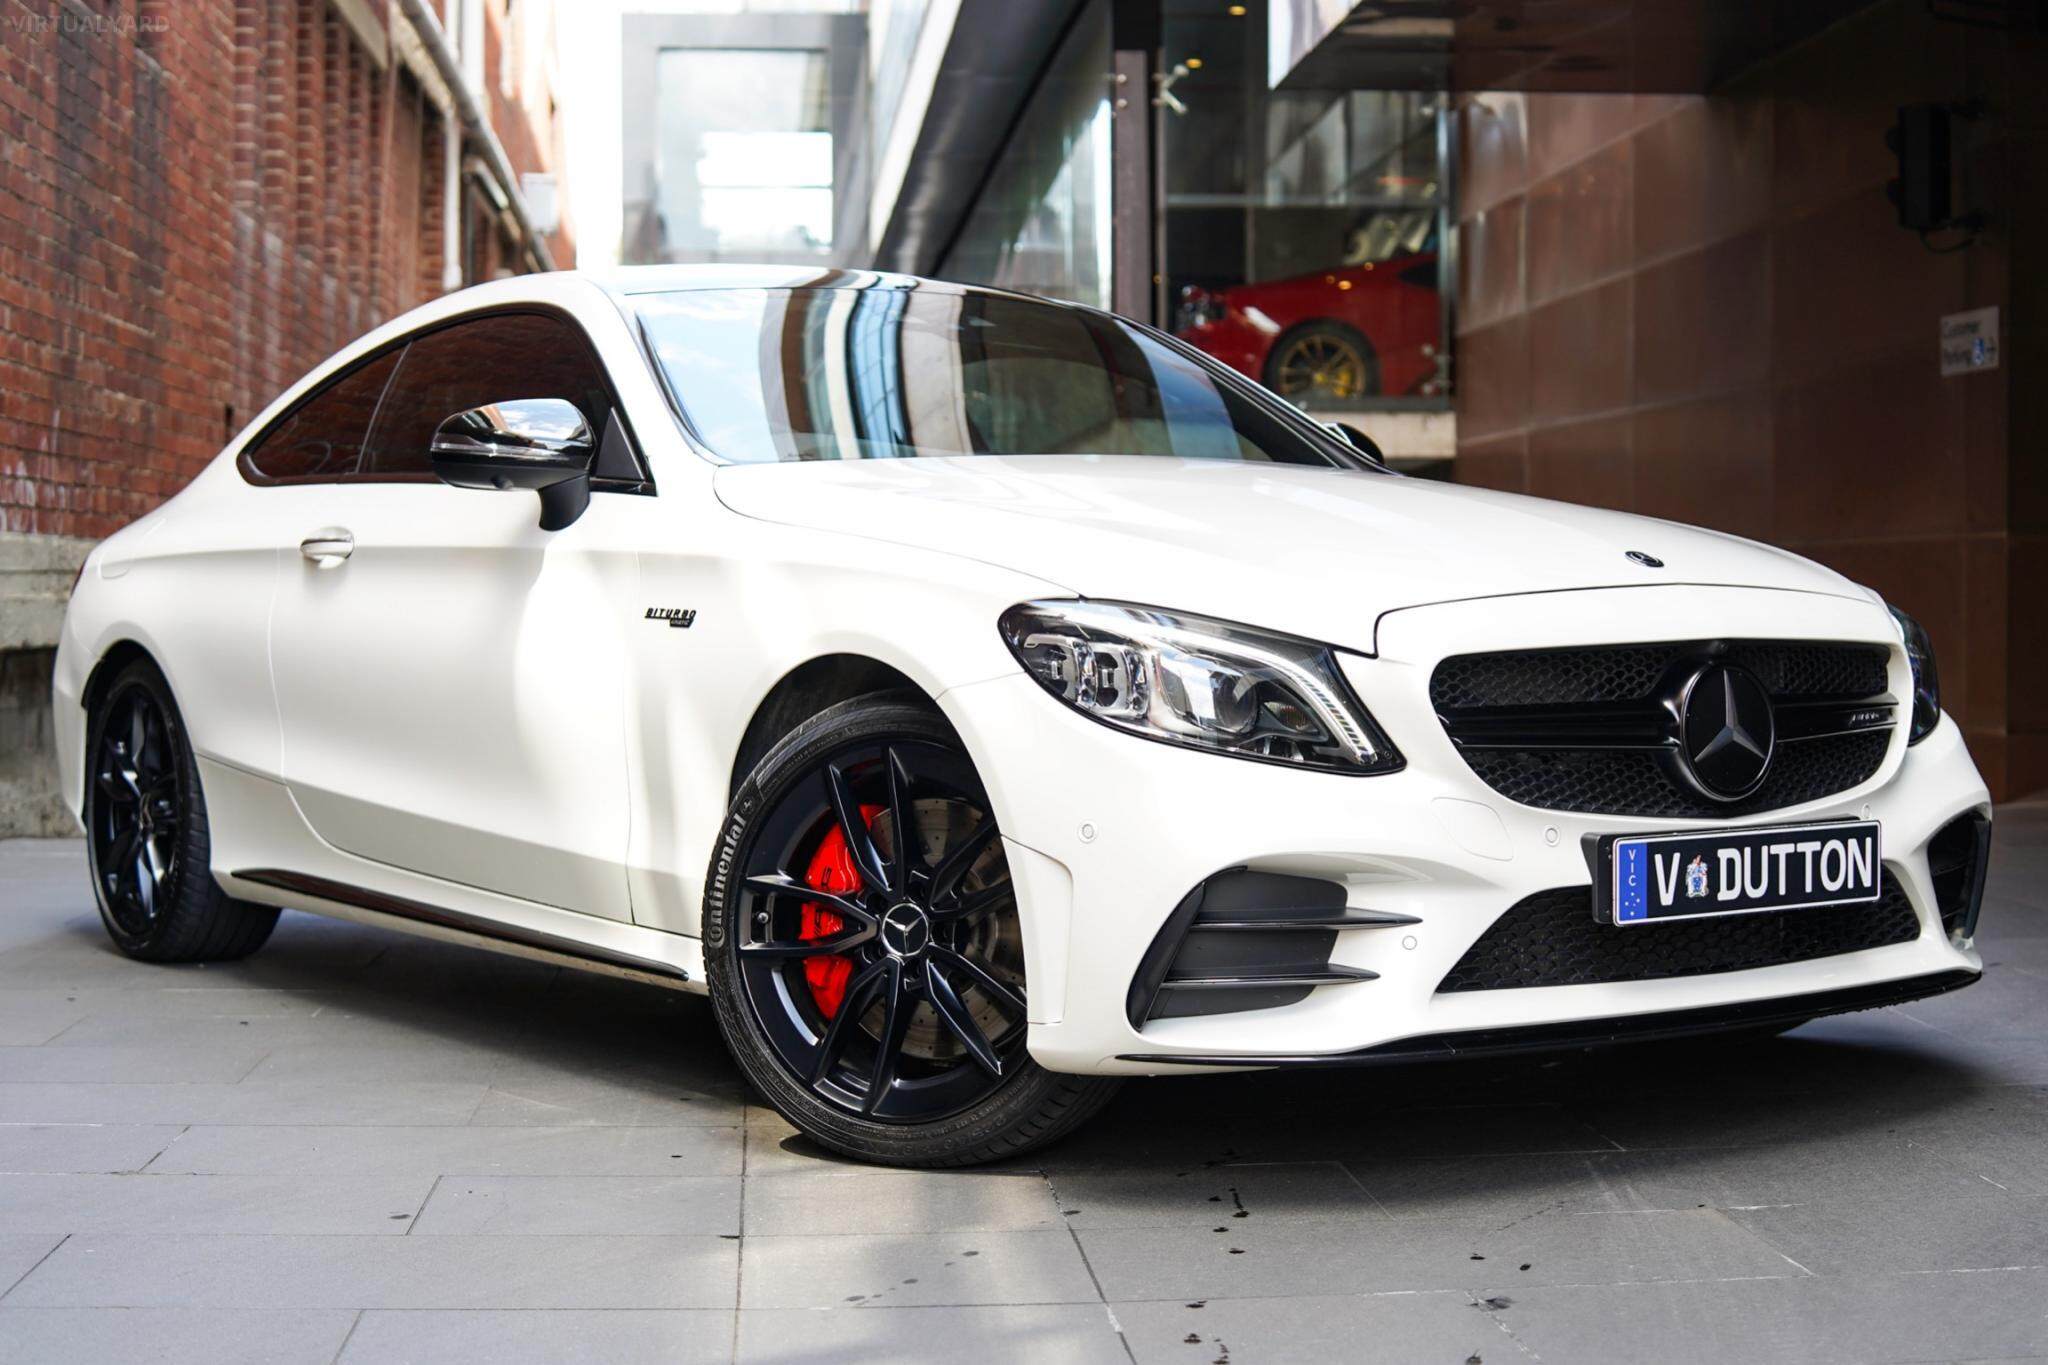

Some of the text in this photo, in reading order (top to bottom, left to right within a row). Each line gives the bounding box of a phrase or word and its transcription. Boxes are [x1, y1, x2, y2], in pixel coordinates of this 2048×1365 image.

[645, 607, 697, 619] BITURBO
[707, 812, 747, 949] Continental
[1627, 848, 1637, 888] VIC
[1654, 837, 1872, 906] V DUTTON
